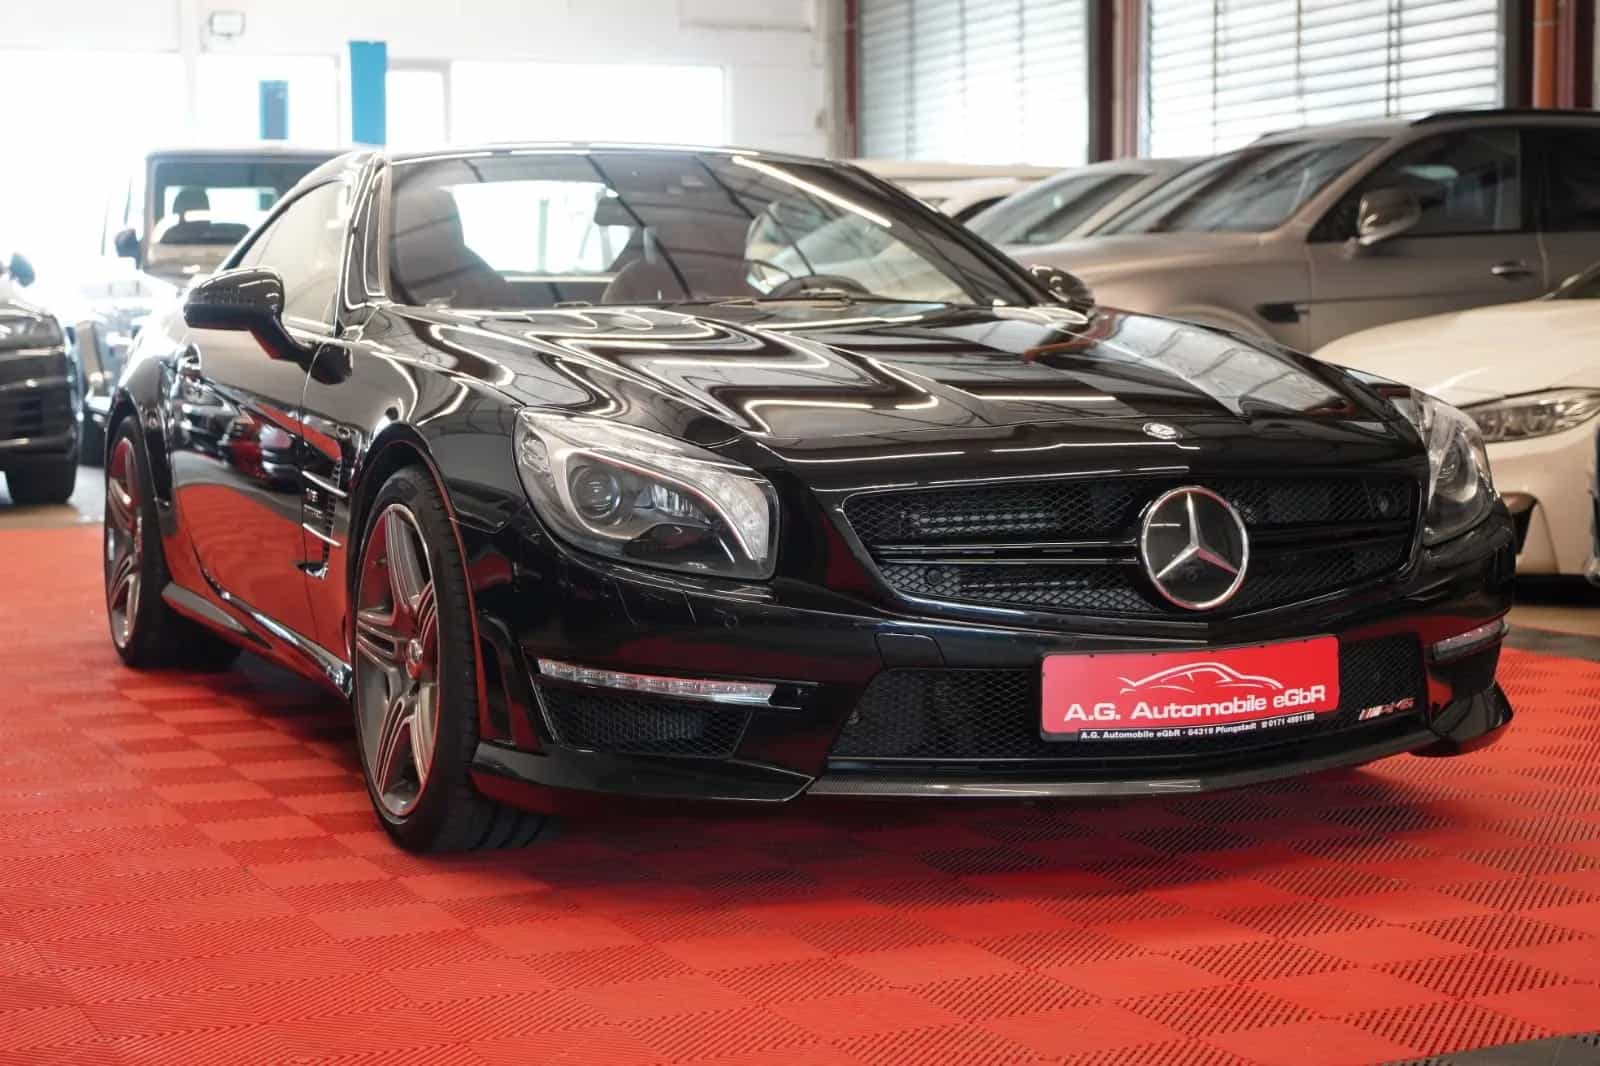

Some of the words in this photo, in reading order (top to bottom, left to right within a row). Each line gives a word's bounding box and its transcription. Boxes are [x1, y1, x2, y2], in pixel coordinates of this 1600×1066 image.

[1064, 703, 1120, 721] A.G.
[1131, 696, 1267, 720] Automobile
[1273, 685, 1325, 709] eGbR
[1081, 731, 1100, 739] A.G.
[1102, 730, 1154, 738] Automobile
[1156, 729, 1181, 737] eGbR
[1215, 723, 1257, 733] Pfungstadt
